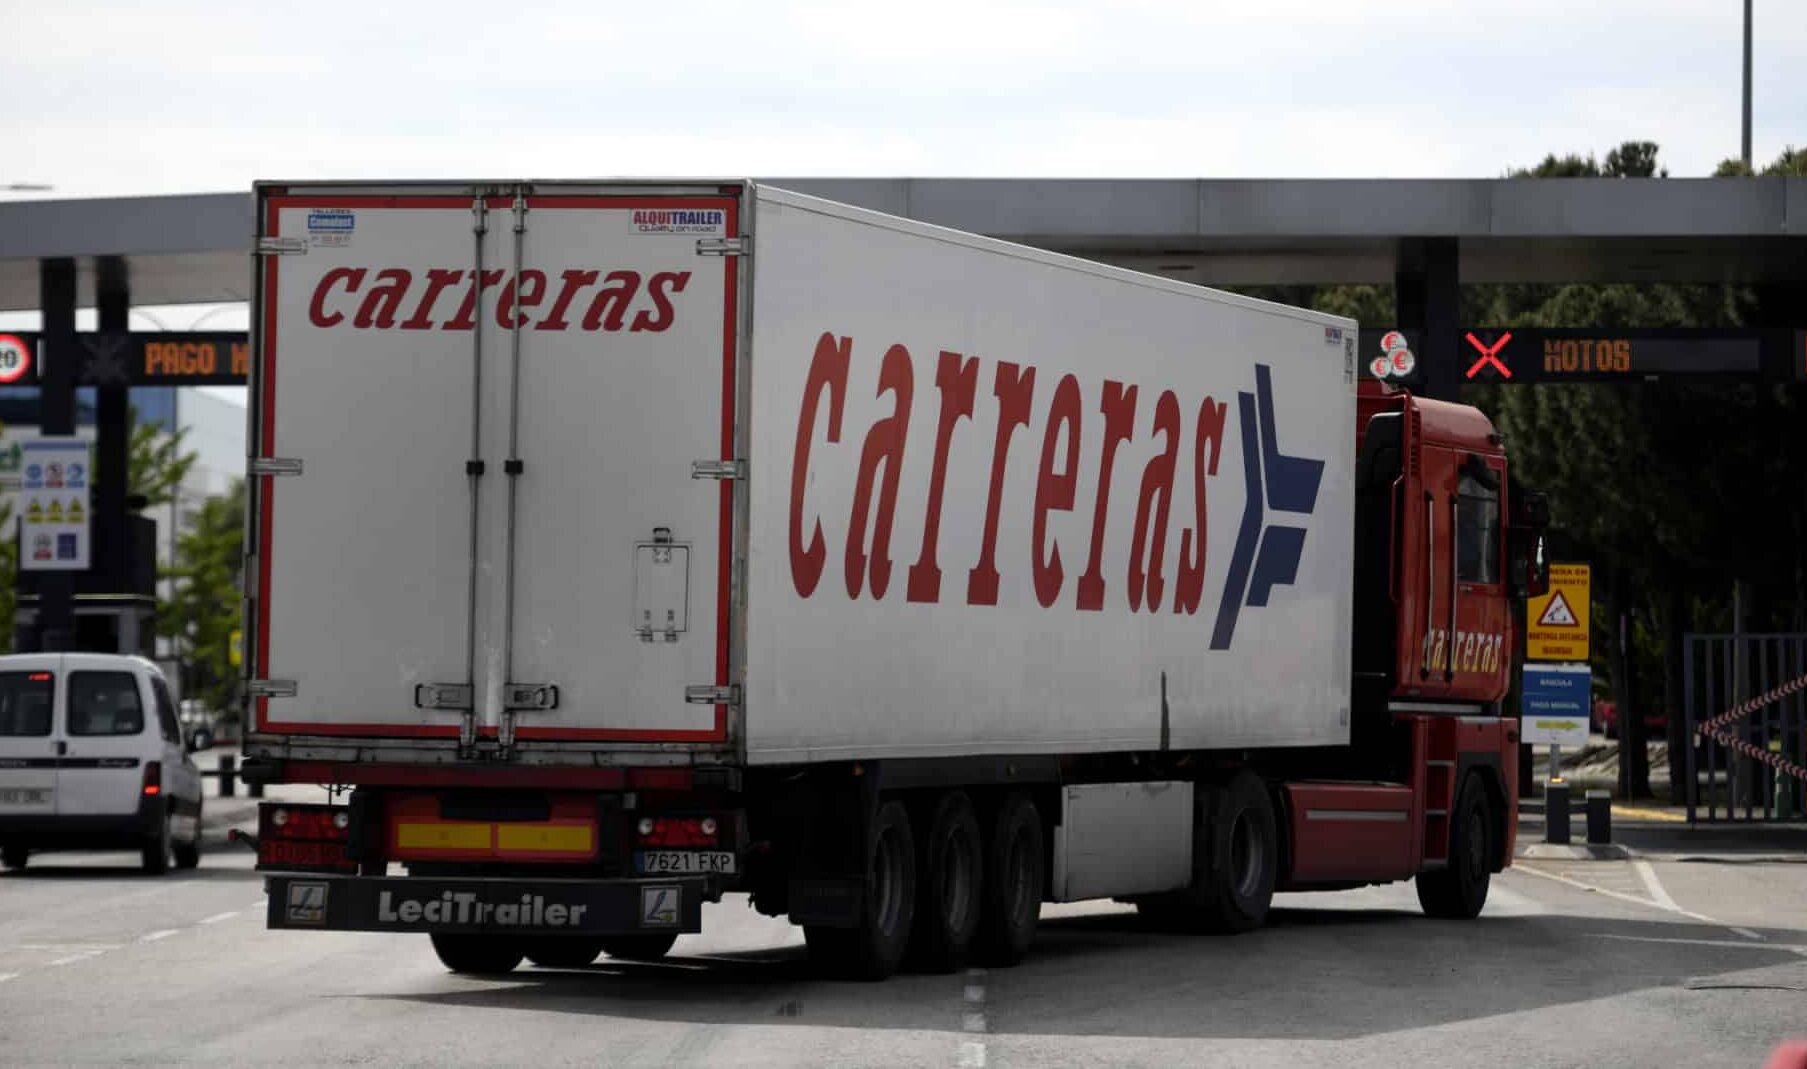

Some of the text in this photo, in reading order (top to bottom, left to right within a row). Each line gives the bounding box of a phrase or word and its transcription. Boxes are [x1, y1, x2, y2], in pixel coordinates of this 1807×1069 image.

[633, 211, 722, 224] ALQUITRAILER
[308, 267, 692, 332] carreras
[144, 342, 216, 375] PAGO
[1544, 339, 1630, 373] MOTOS
[788, 331, 1228, 616] carreras
[647, 853, 731, 871] 7621 FKP
[378, 891, 587, 927] LeciTrailer
